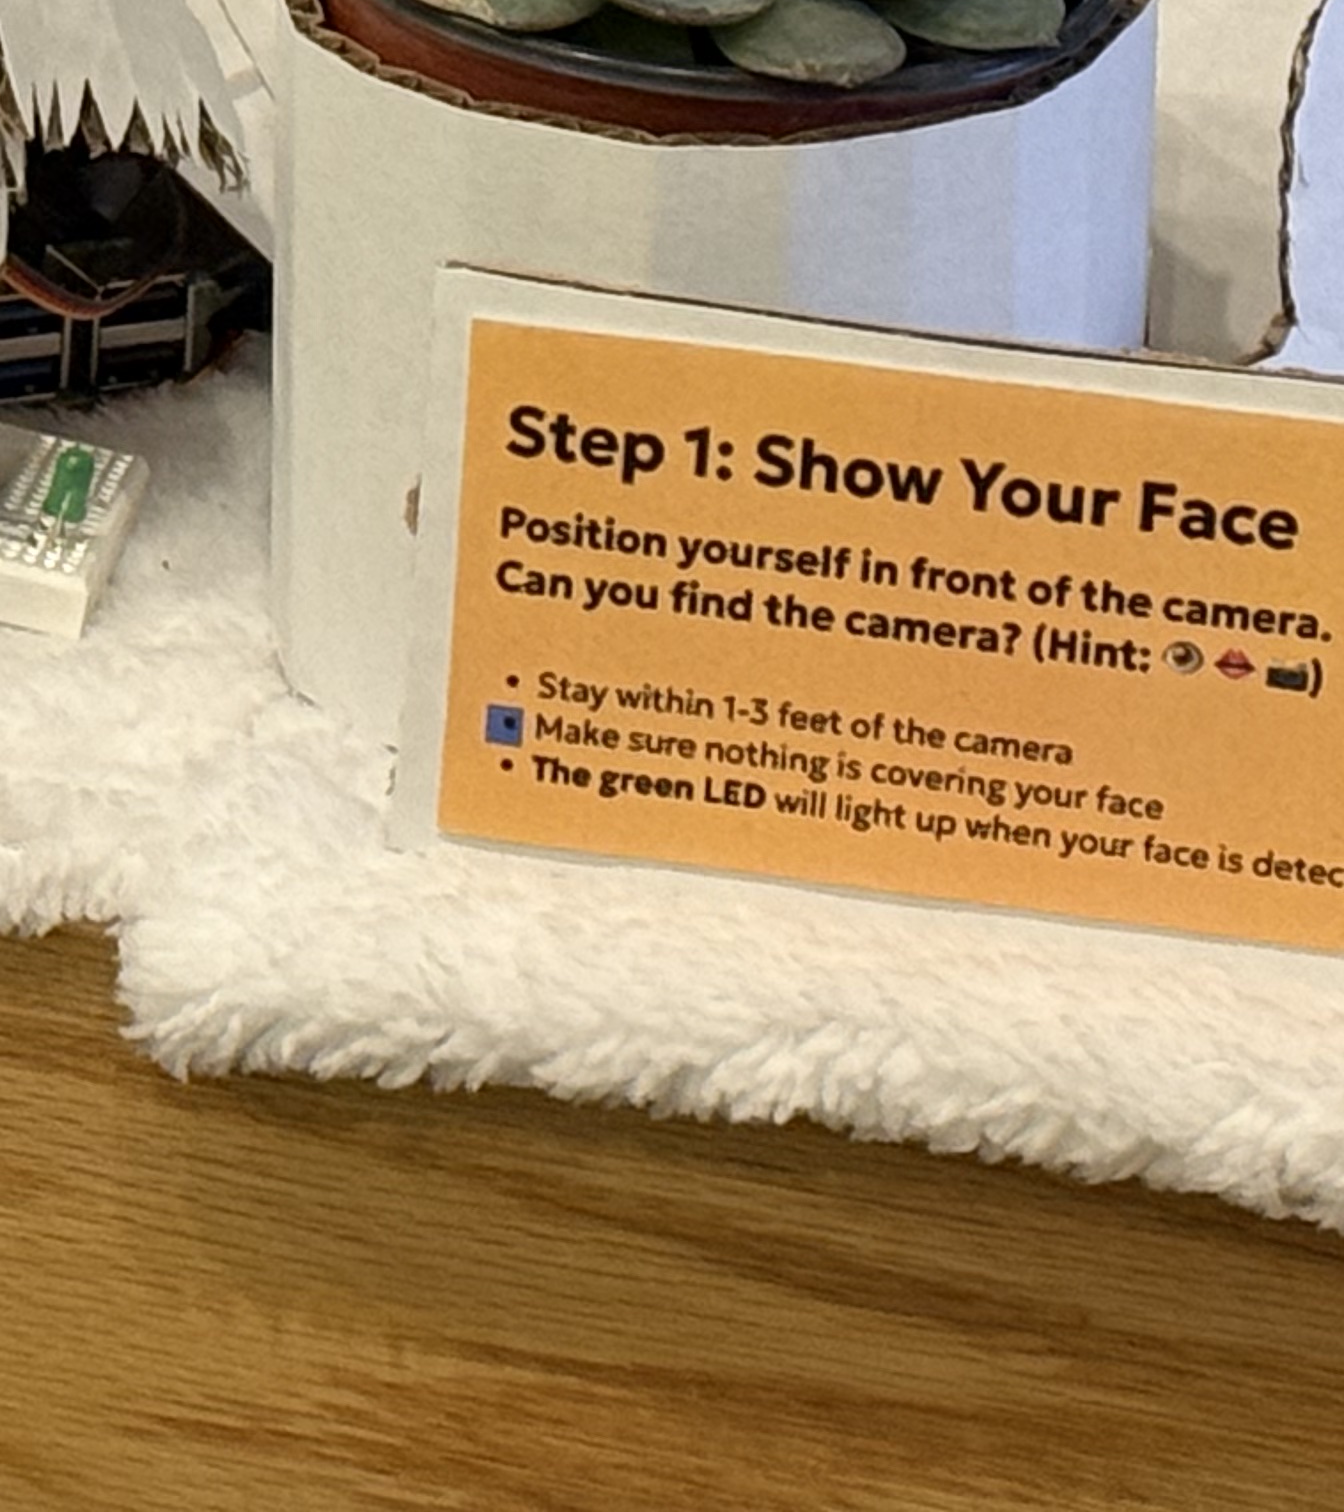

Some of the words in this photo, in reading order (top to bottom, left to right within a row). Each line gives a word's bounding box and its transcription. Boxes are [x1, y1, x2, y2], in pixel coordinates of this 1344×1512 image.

[506, 406, 665, 485] Step
[684, 427, 734, 481] 1:
[754, 434, 943, 505] Show
[961, 459, 1121, 526] Your
[1139, 481, 1298, 550] Face
[496, 560, 573, 599] Can
[583, 578, 658, 611] you
[670, 580, 753, 622] find
[763, 594, 835, 631] the
[845, 611, 1022, 655] camera?
[1033, 623, 1150, 673] (Hint:
[501, 506, 667, 557] Position
[677, 537, 851, 579] yourself
[860, 548, 898, 586] in
[910, 557, 1016, 601] front
[1027, 575, 1072, 607] of
[1080, 580, 1152, 618] the
[1163, 598, 1331, 642] camera.
[536, 714, 620, 749] Make
[629, 732, 696, 758] sure
[705, 741, 830, 783] nothing
[837, 752, 861, 780] is
[871, 764, 1006, 806] covering
[1014, 782, 1087, 809] your
[1097, 785, 1163, 819] face
[539, 672, 608, 712] Stay
[616, 684, 713, 718] within
[724, 696, 768, 725] 1-3
[779, 702, 841, 735] feet
[851, 713, 884, 739] of
[893, 718, 946, 748] the
[954, 732, 1072, 765] camera
[532, 755, 591, 787] The
[599, 771, 694, 800] green
[704, 777, 766, 808] LED
[775, 790, 826, 818] will
[836, 794, 905, 831] light
[916, 812, 956, 841] up
[966, 815, 1051, 847] when
[1060, 832, 1133, 858] your
[1144, 835, 1209, 869] face
[1219, 846, 1243, 873] is
